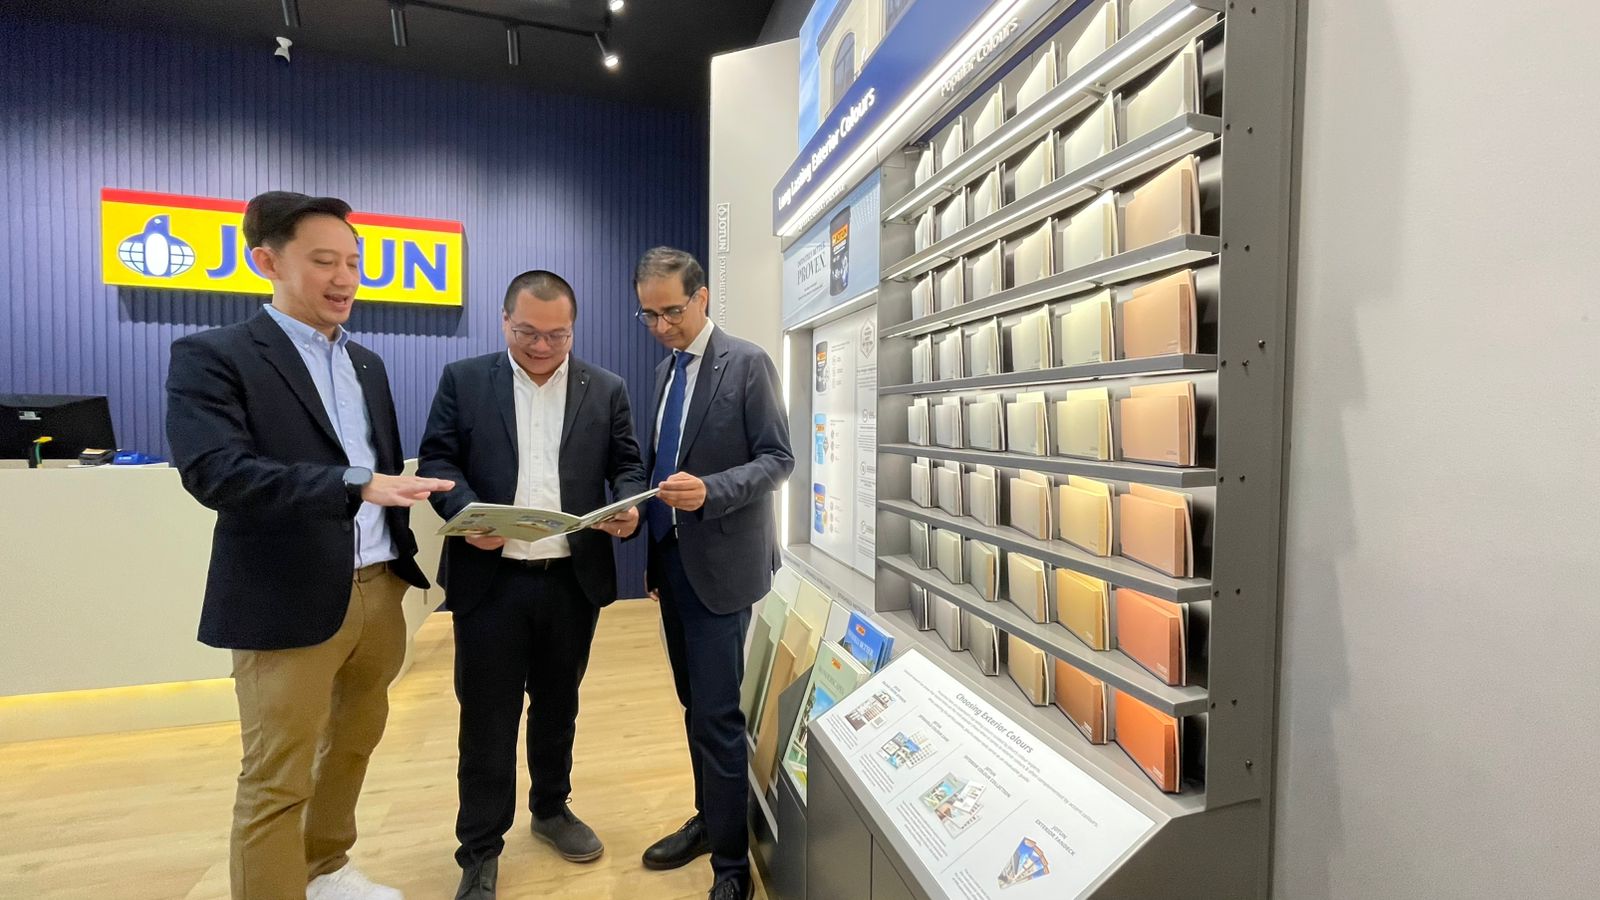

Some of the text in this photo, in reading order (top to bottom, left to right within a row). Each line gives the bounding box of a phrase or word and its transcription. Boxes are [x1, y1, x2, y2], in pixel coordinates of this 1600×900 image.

[778, 187, 792, 211] Long
[790, 162, 812, 196] Lasting
[811, 127, 840, 172] Exterior
[839, 87, 876, 138] Colours
[718, 216, 727, 250] JOTUN
[207, 224, 447, 292] JUN
[956, 693, 1034, 753] Choosing Exterior Colours
[1035, 819, 1075, 856] EXTERIOR FANDECK
[1050, 825, 1068, 840] JOTUN
